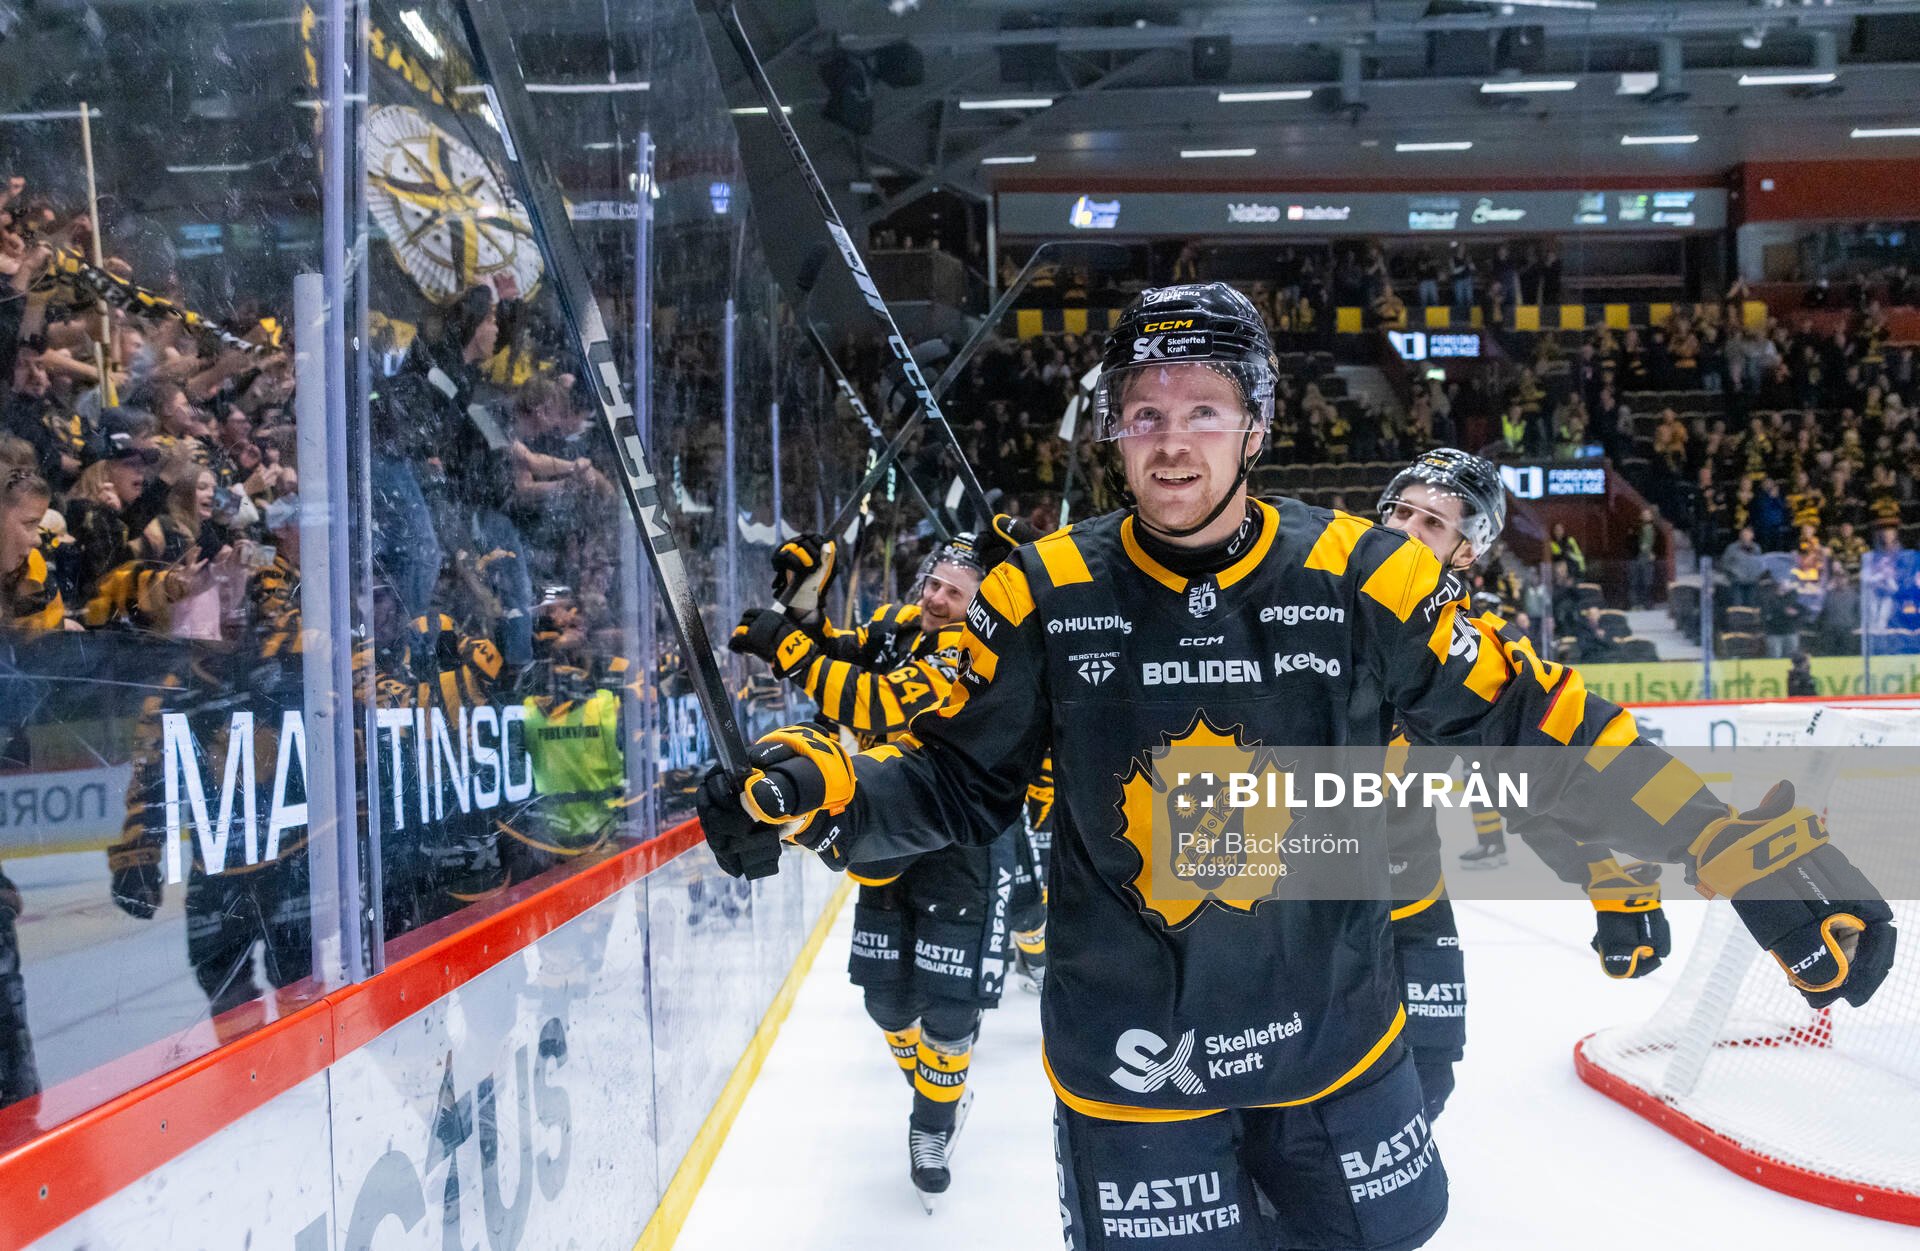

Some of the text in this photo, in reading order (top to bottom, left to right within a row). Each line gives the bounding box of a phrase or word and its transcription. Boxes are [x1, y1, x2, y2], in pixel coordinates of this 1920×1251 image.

[1144, 319, 1194, 333] CCM
[1133, 335, 1165, 360] SK
[1167, 336, 1206, 346] Skellefteå
[1167, 345, 1187, 354] Kraft
[888, 335, 942, 419] CCM
[588, 339, 679, 555] CCM
[1188, 591, 1217, 614] 50
[1189, 582, 1215, 597] SHL
[1259, 605, 1345, 626] engcon
[1179, 636, 1225, 646] CCM
[1068, 651, 1120, 661] BERGTEAMET
[886, 666, 931, 705] 64
[1142, 660, 1263, 686] BOLIDEN
[761, 777, 785, 813] CCM
[915, 938, 965, 964] BASTU
[1791, 944, 1827, 974] CCM
[1408, 1003, 1466, 1018] PRODUK
[1204, 1012, 1303, 1055] Skellefteå
[1109, 1028, 1207, 1095] SK
[1208, 1052, 1264, 1079] Kraft
[1098, 1171, 1221, 1211] BASTU
[1102, 1203, 1241, 1238] PRODUKTER
